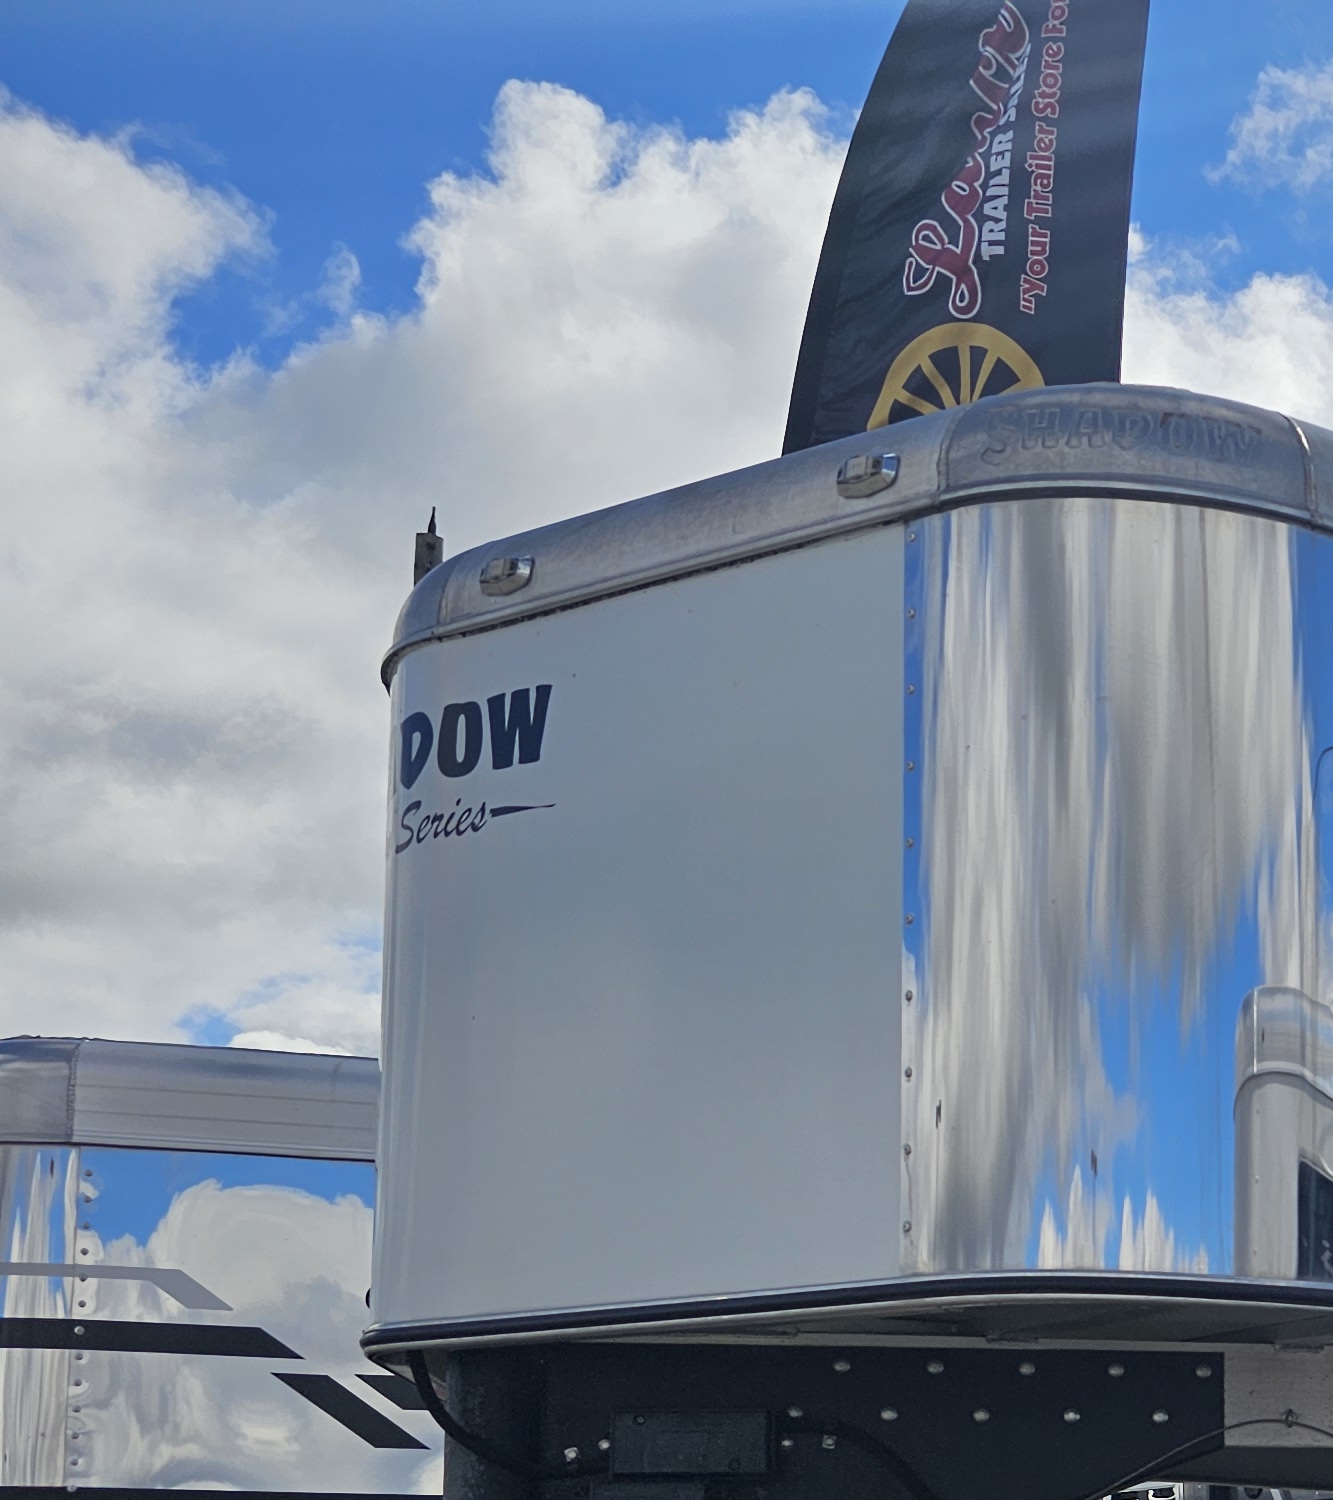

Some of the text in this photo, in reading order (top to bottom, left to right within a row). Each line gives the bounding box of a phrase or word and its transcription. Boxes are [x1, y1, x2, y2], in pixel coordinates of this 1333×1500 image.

[1032, 42, 1065, 118] Store
[981, 129, 1013, 261] TRAILER
[1025, 121, 1056, 219] Trailer
[979, 406, 1262, 465] SHADOW
[395, 799, 488, 854] Series
